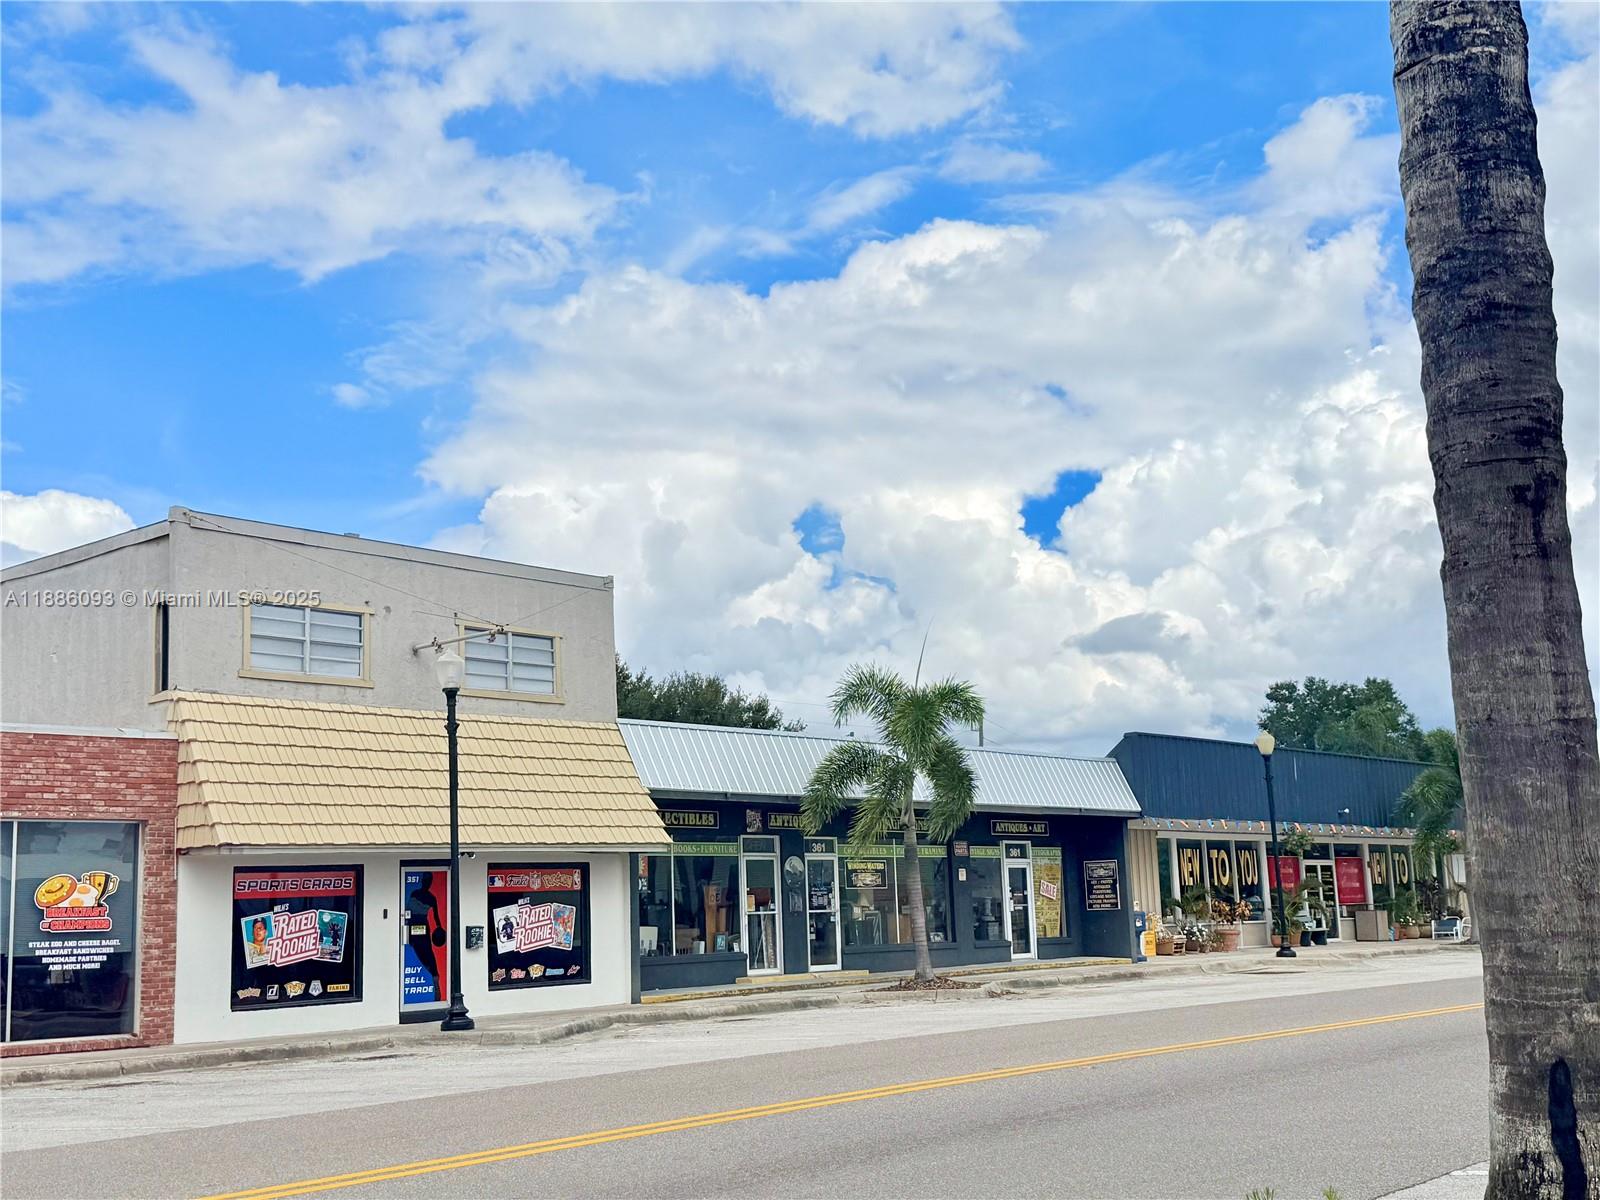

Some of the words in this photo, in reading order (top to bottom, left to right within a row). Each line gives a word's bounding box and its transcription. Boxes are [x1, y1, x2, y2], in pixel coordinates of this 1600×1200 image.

[996, 822, 1028, 833] ANTIQUES
[1033, 824, 1046, 833] ART
[674, 845, 697, 853] BOOKS
[700, 845, 737, 853] FURNITURE
[812, 843, 826, 852] 361
[1009, 848, 1021, 857] 361
[1180, 848, 1200, 886] NEW
[1209, 849, 1230, 886] TO
[1238, 849, 1258, 886] YOU
[1370, 852, 1387, 885] NEW
[1393, 852, 1408, 884] TO
[236, 880, 300, 892] SPORTS
[301, 878, 354, 890] CARDS
[1041, 881, 1057, 898] SALE
[46, 907, 106, 917] BREAKFAST
[519, 905, 551, 930] RATED
[50, 919, 110, 930] CHAMPIONS
[275, 912, 316, 939] RATED
[515, 925, 553, 951] ROOKIE
[29, 941, 50, 949] STEAK
[269, 934, 318, 963] ROOKIE
[35, 948, 72, 956] BREAKFAST
[405, 976, 426, 984] SELL
[327, 984, 350, 992] PANINI
[405, 986, 434, 994] TRADE
